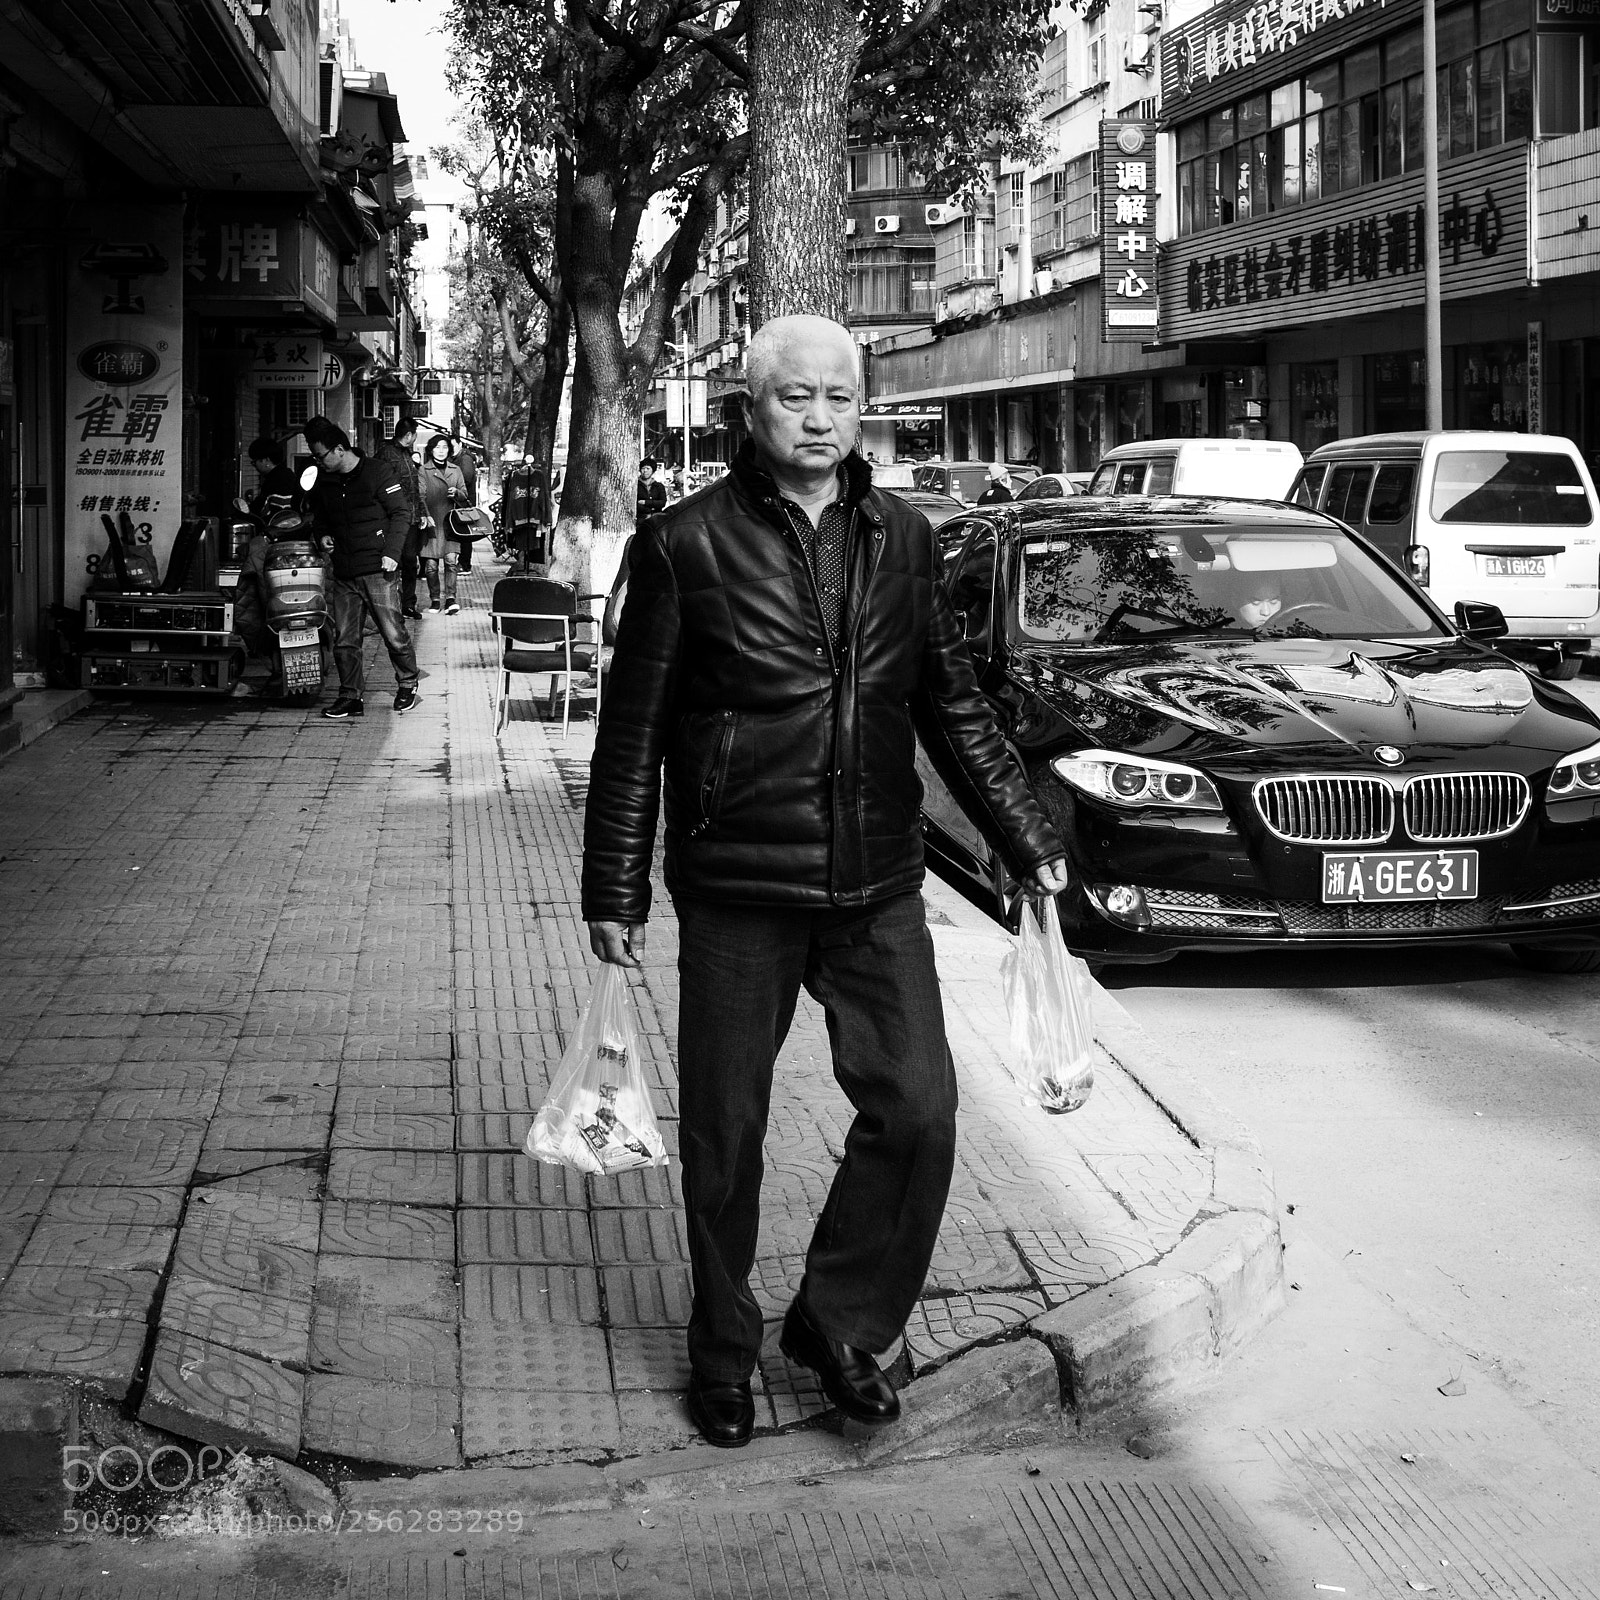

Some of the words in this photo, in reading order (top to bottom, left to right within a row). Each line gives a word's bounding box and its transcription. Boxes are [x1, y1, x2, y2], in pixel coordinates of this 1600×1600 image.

[1115, 162, 1149, 298] 调解中心
[94, 351, 145, 376] 雀霸
[75, 394, 169, 445] 雀霸
[77, 448, 165, 466] 全自动麻将机
